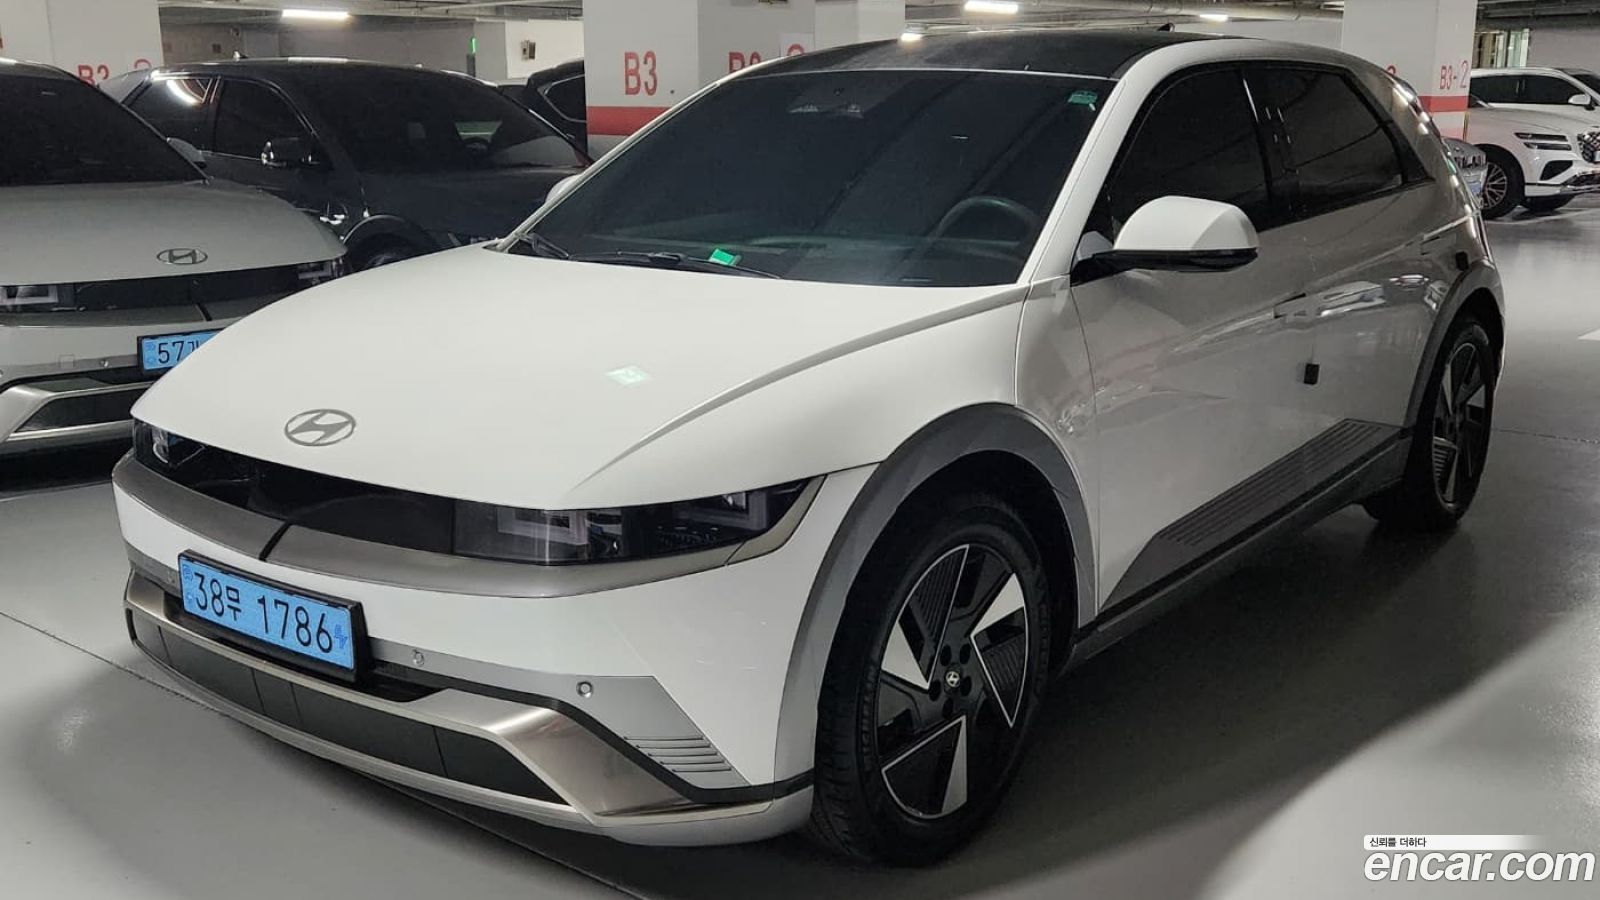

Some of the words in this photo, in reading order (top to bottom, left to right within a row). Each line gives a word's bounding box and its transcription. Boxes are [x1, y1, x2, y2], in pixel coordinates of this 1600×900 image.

[624, 51, 657, 96] B3
[194, 572, 242, 621] 38무
[257, 595, 333, 653] 1786
